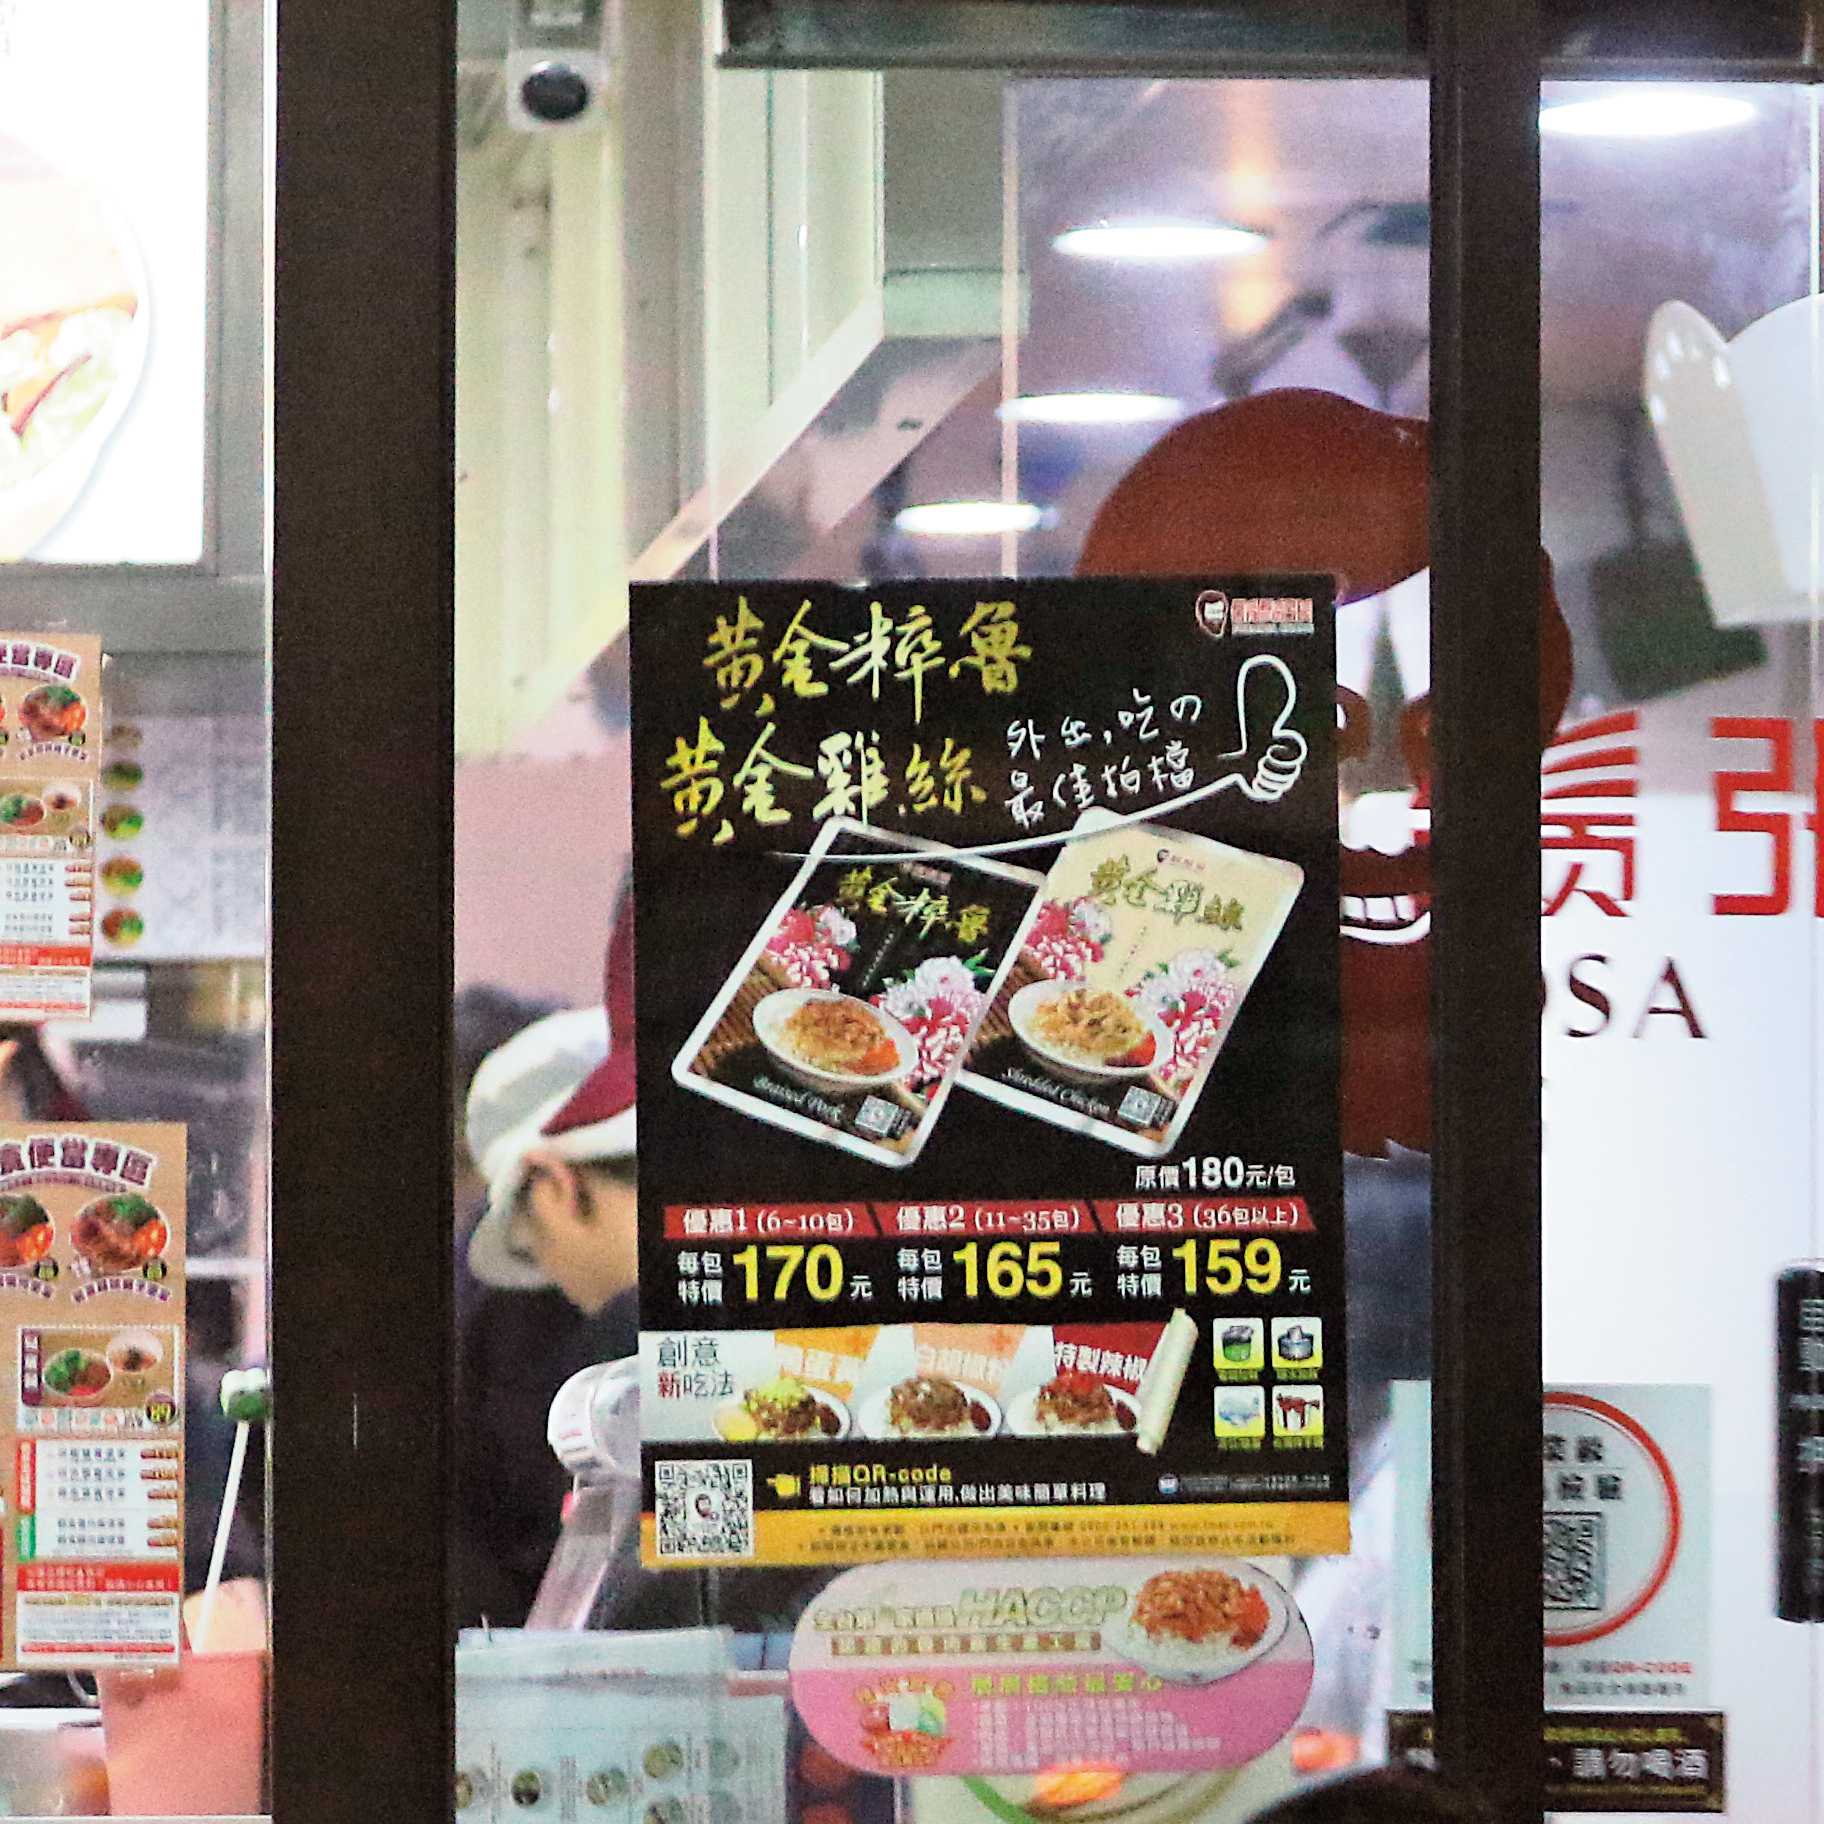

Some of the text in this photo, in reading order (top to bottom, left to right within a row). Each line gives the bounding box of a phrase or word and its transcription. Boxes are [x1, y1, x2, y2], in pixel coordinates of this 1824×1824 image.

[660, 716, 988, 846] 黃金雞絲
[1004, 739, 1195, 829] 最佳拍檔
[1541, 954, 1711, 1040] SA
[1135, 1155, 1296, 1190] 原價180元/包
[677, 1249, 723, 1276] 每包
[731, 1244, 873, 1301] 170 元
[897, 1247, 943, 1274] 每包
[951, 1241, 1094, 1299] 165 元
[1116, 1244, 1163, 1271] 每包
[1171, 1238, 1312, 1296] 159 元
[677, 1276, 723, 1304] 特價
[898, 1274, 944, 1302] 特價
[1118, 1272, 1164, 1300] 特價
[657, 1336, 720, 1368] 創意
[657, 1369, 735, 1399] 新吃法
